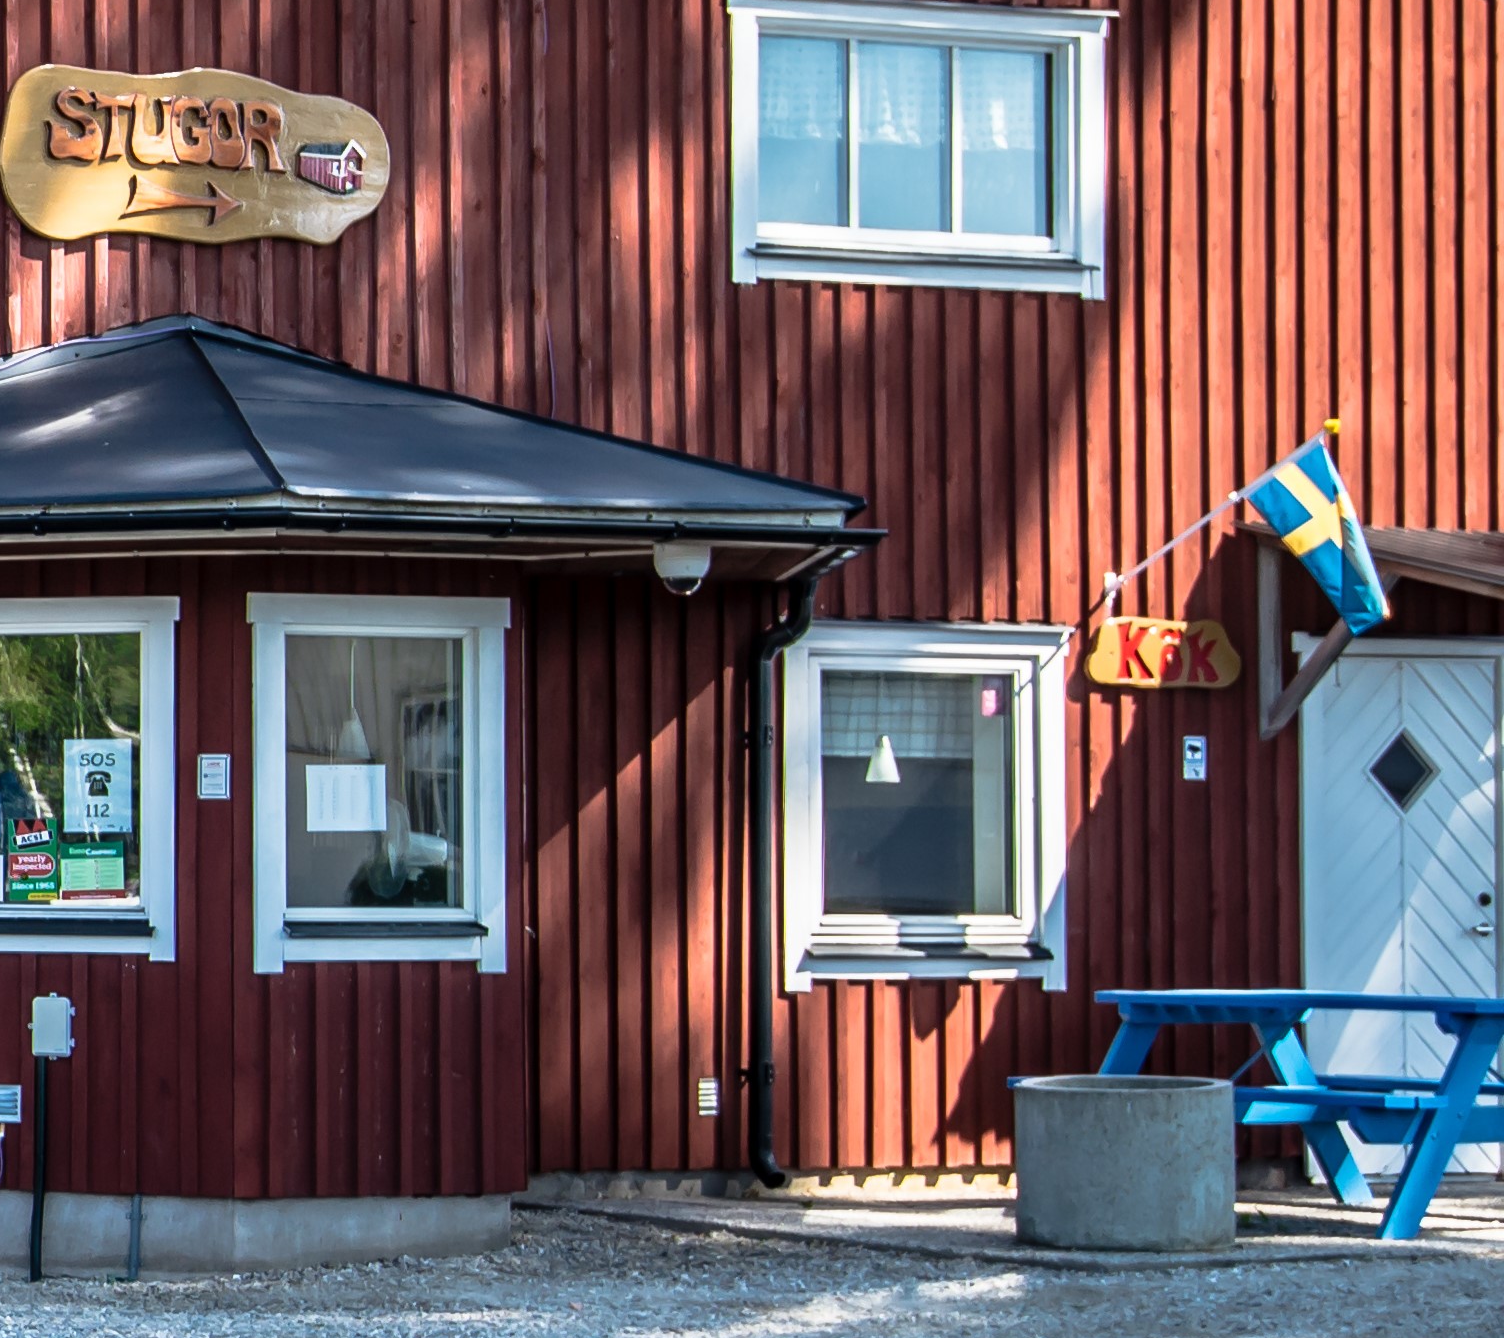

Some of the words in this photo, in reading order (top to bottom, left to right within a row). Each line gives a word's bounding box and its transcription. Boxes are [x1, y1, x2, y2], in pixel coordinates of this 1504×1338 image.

[45, 86, 287, 172] STUGOR
[79, 752, 116, 767] SOS
[86, 803, 110, 818] 112
[18, 854, 46, 865] yearly
